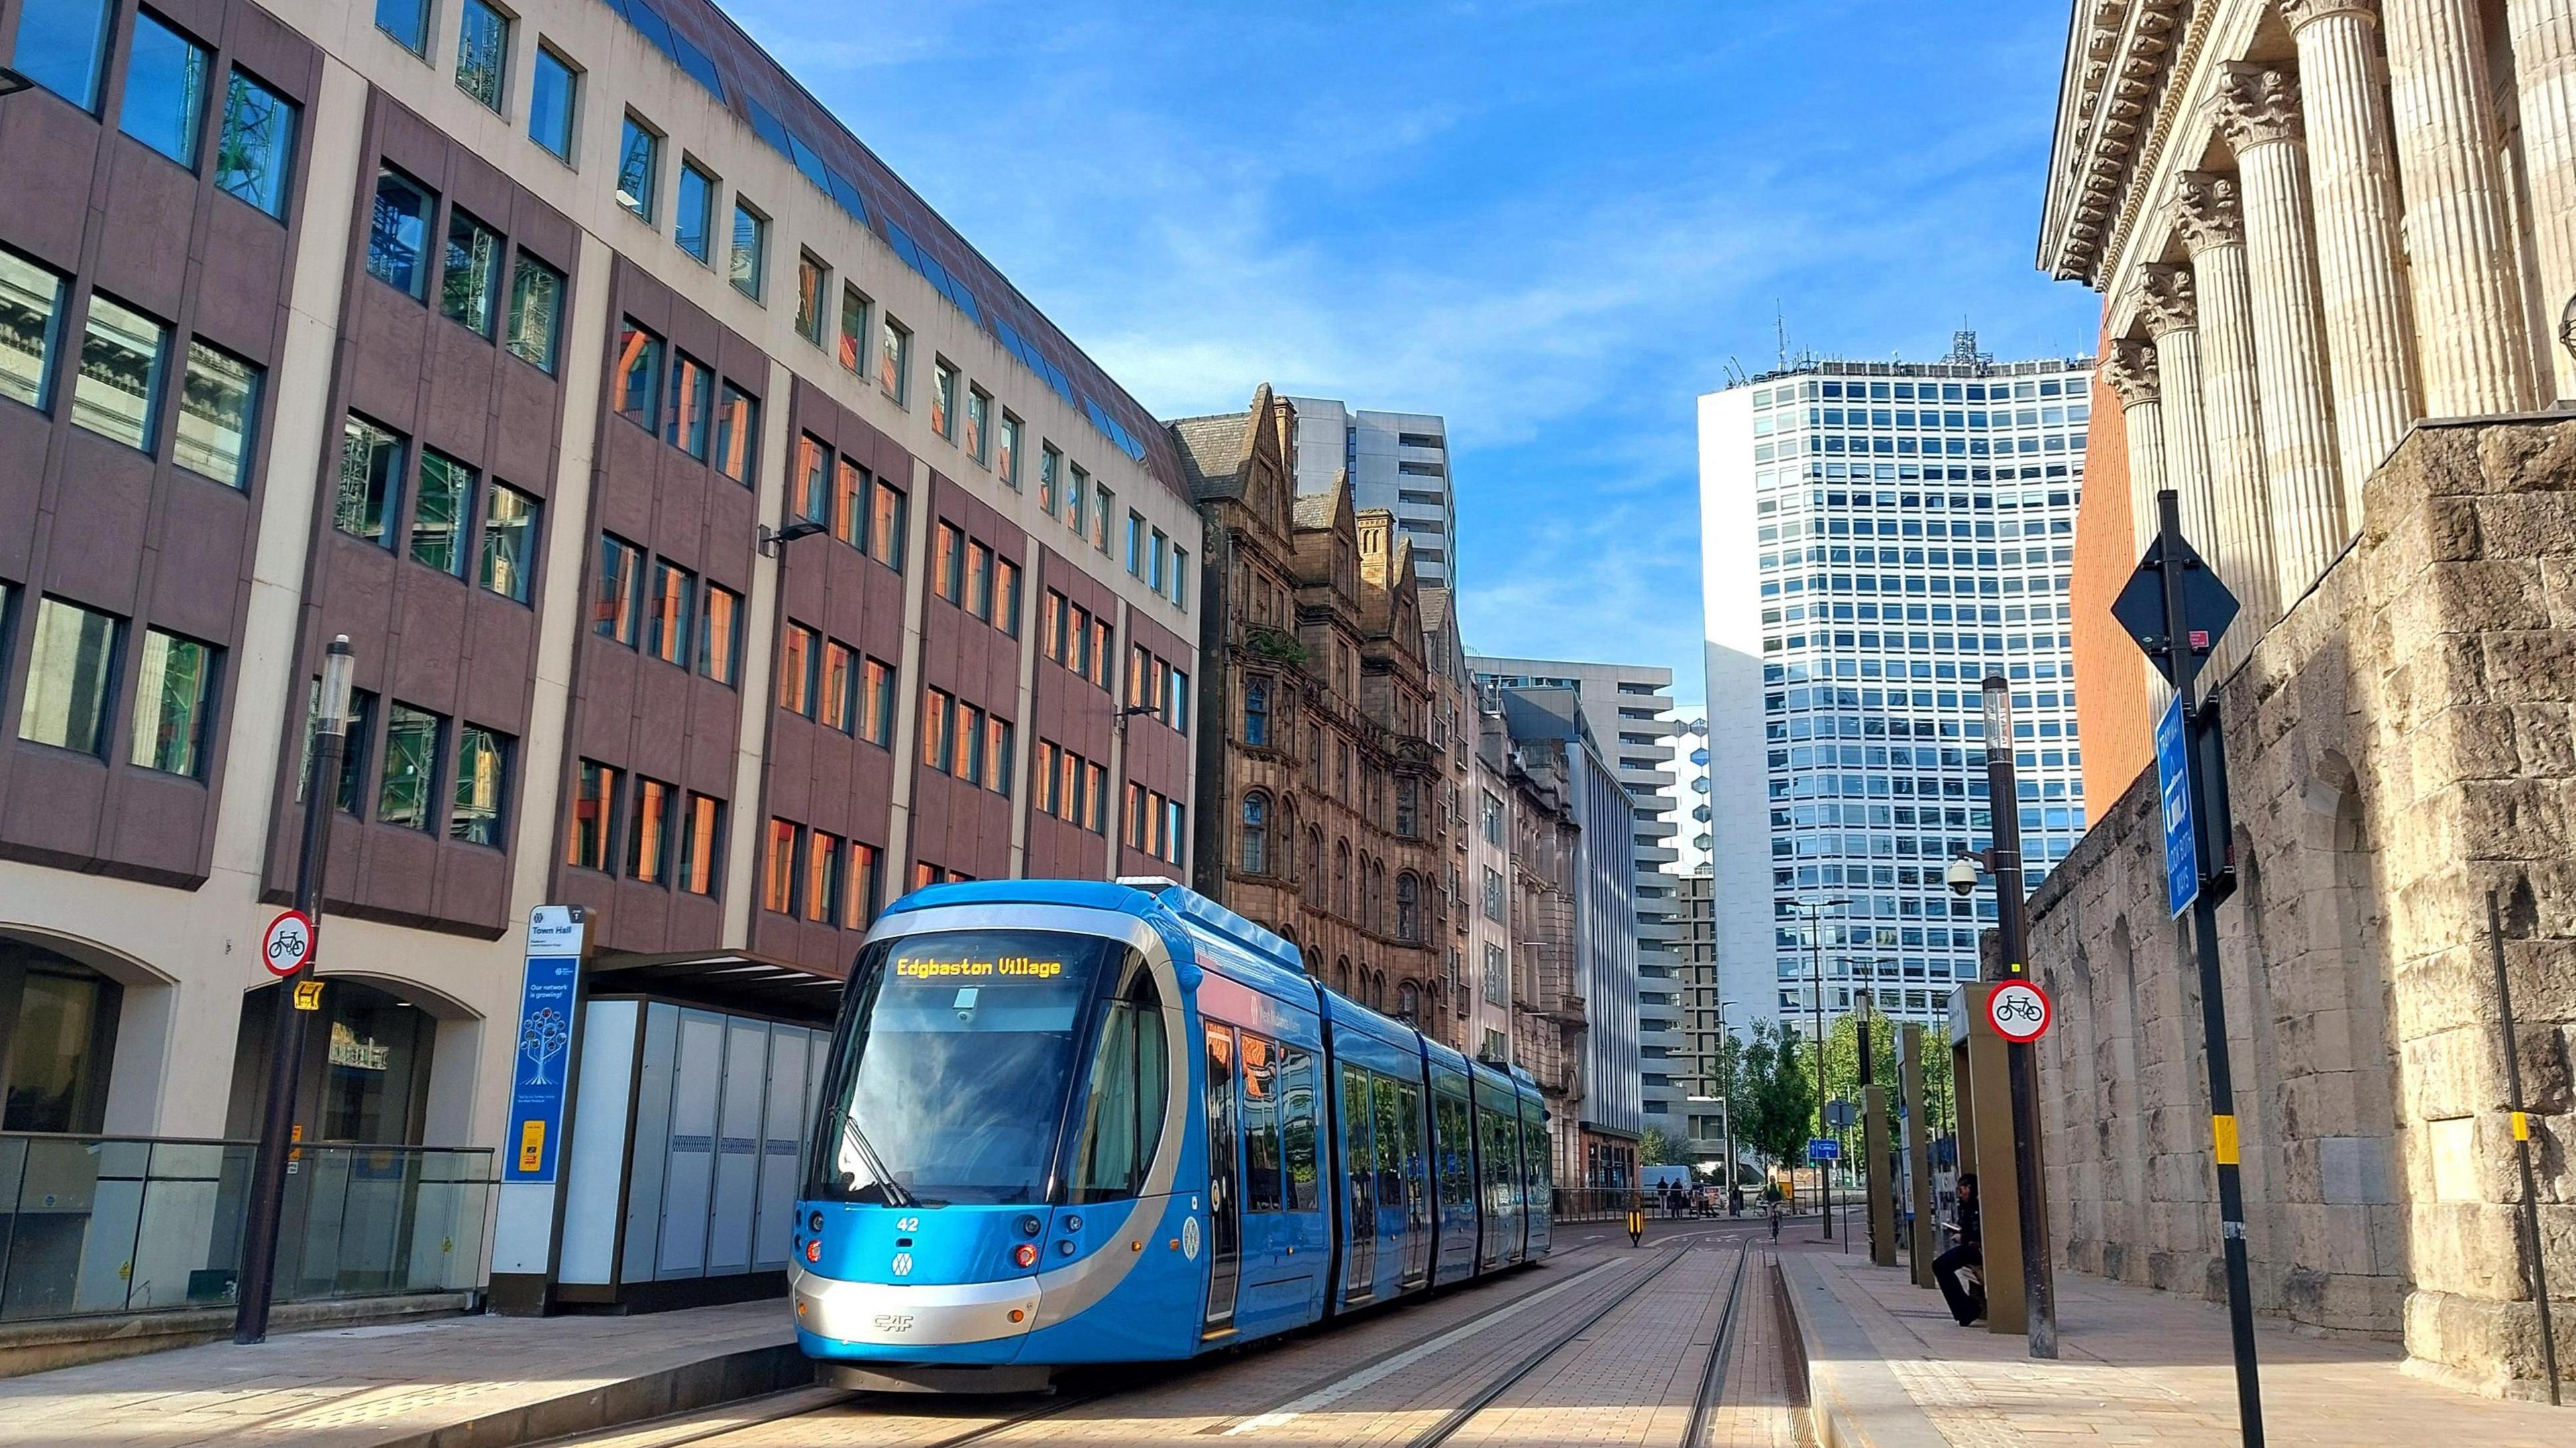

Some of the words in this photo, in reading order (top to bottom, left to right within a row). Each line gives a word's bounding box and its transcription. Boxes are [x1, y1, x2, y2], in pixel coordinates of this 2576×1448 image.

[2159, 709, 2180, 759] TRAMWAY
[2179, 828, 2192, 861] BOTH
[2176, 865, 2189, 897] WAYS
[532, 926, 553, 934] Town
[555, 926, 572, 934] Hall
[896, 958, 993, 979] Edgbaston
[998, 957, 1061, 978] Village
[896, 1217, 920, 1233] 42
[874, 1315, 914, 1333] CAF
